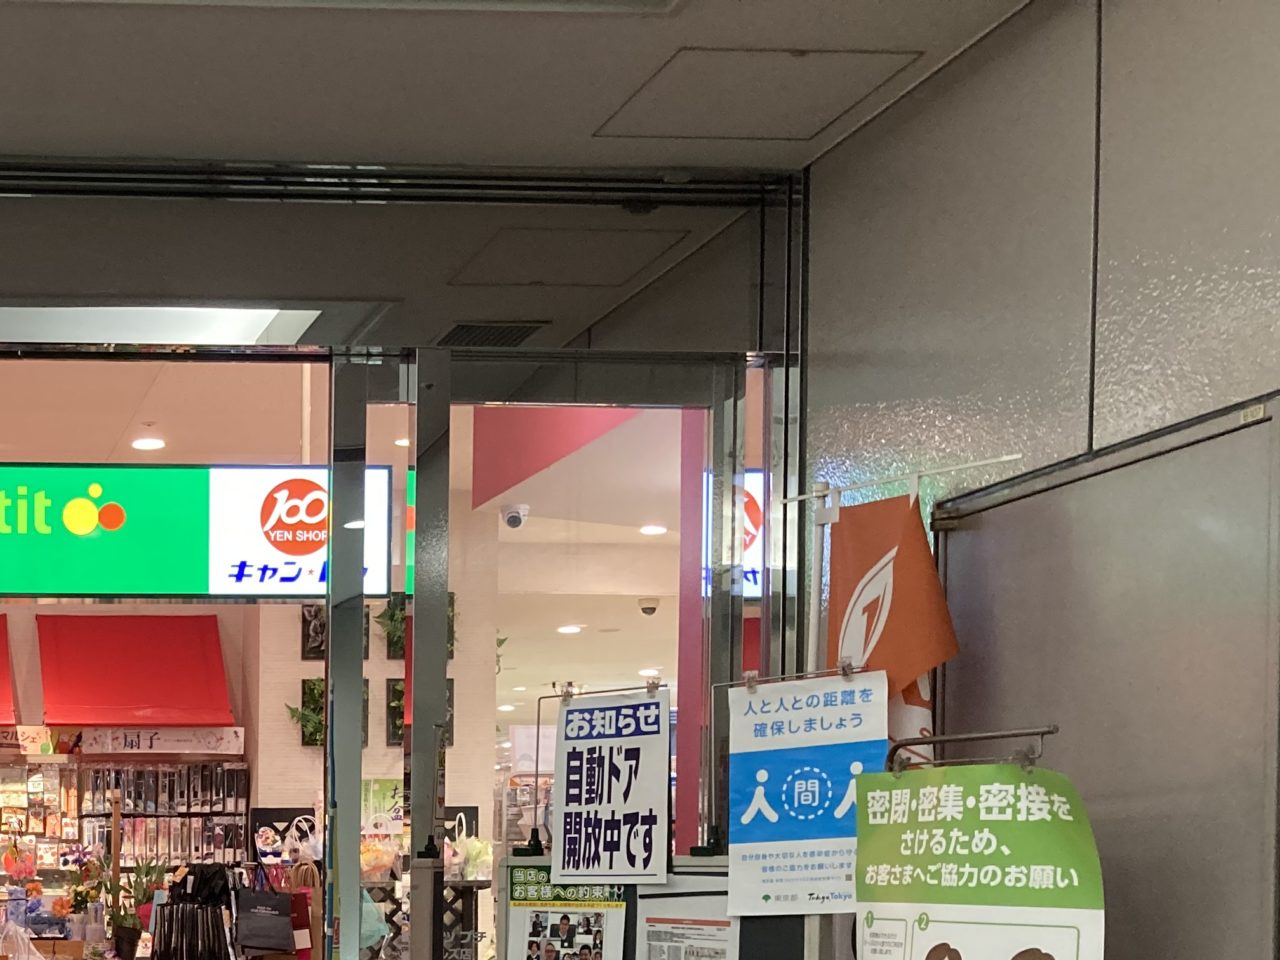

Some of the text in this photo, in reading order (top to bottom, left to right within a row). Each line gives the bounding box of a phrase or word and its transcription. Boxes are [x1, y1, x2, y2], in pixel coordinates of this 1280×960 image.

[269, 530, 292, 541] YEN
[744, 688, 873, 716] 人と人との距離を
[565, 705, 660, 738] お知らせ
[753, 713, 863, 738] 確保しましょう
[565, 746, 641, 806] 自動ドア
[794, 779, 819, 808] 間
[866, 783, 1074, 825] 密閉・密集・密接を
[561, 808, 658, 871] 開放中です
[900, 828, 1011, 856] さけるため、
[864, 863, 1079, 889] お客さまへご協力のお願い
